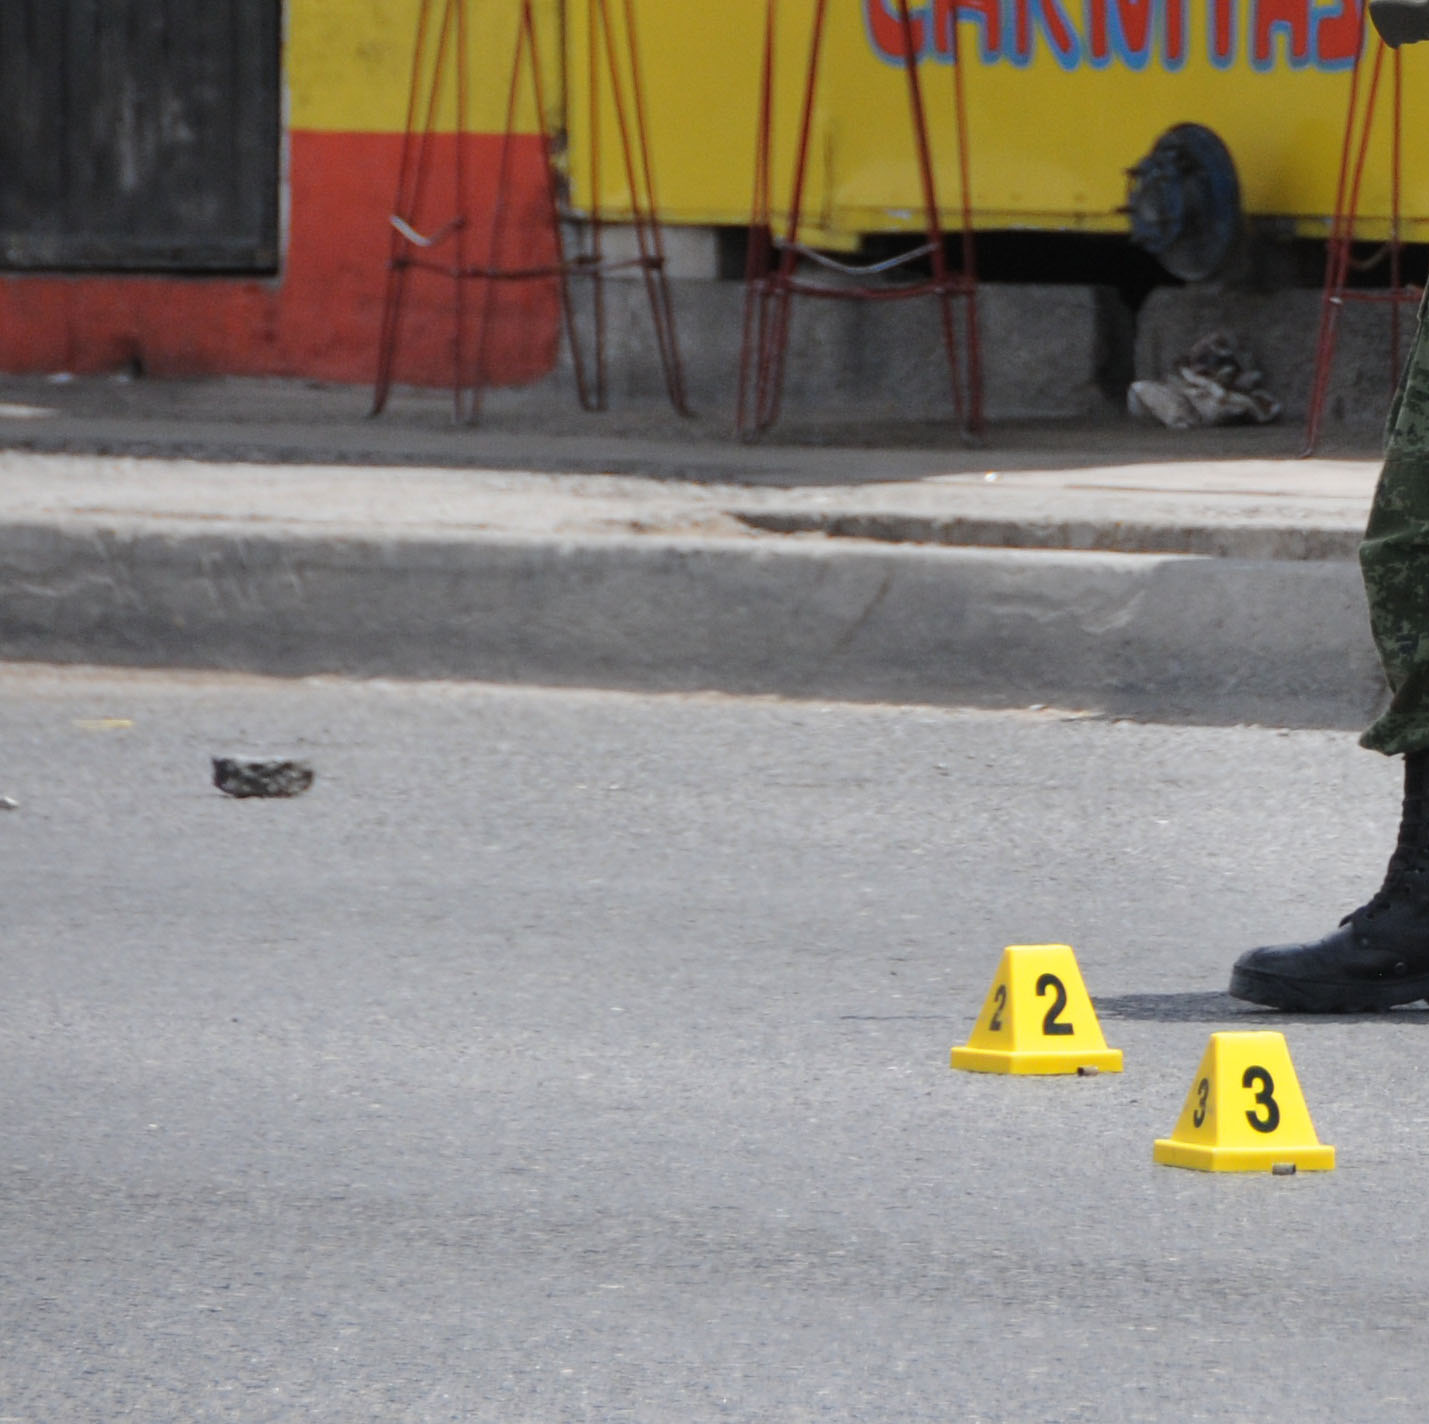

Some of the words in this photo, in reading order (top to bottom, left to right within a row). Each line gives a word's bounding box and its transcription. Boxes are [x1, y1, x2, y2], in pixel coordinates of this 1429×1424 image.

[988, 984, 1007, 1032] 2
[1035, 972, 1075, 1036] 2
[1192, 1077, 1210, 1129] 3
[1241, 1065, 1281, 1134] 3
